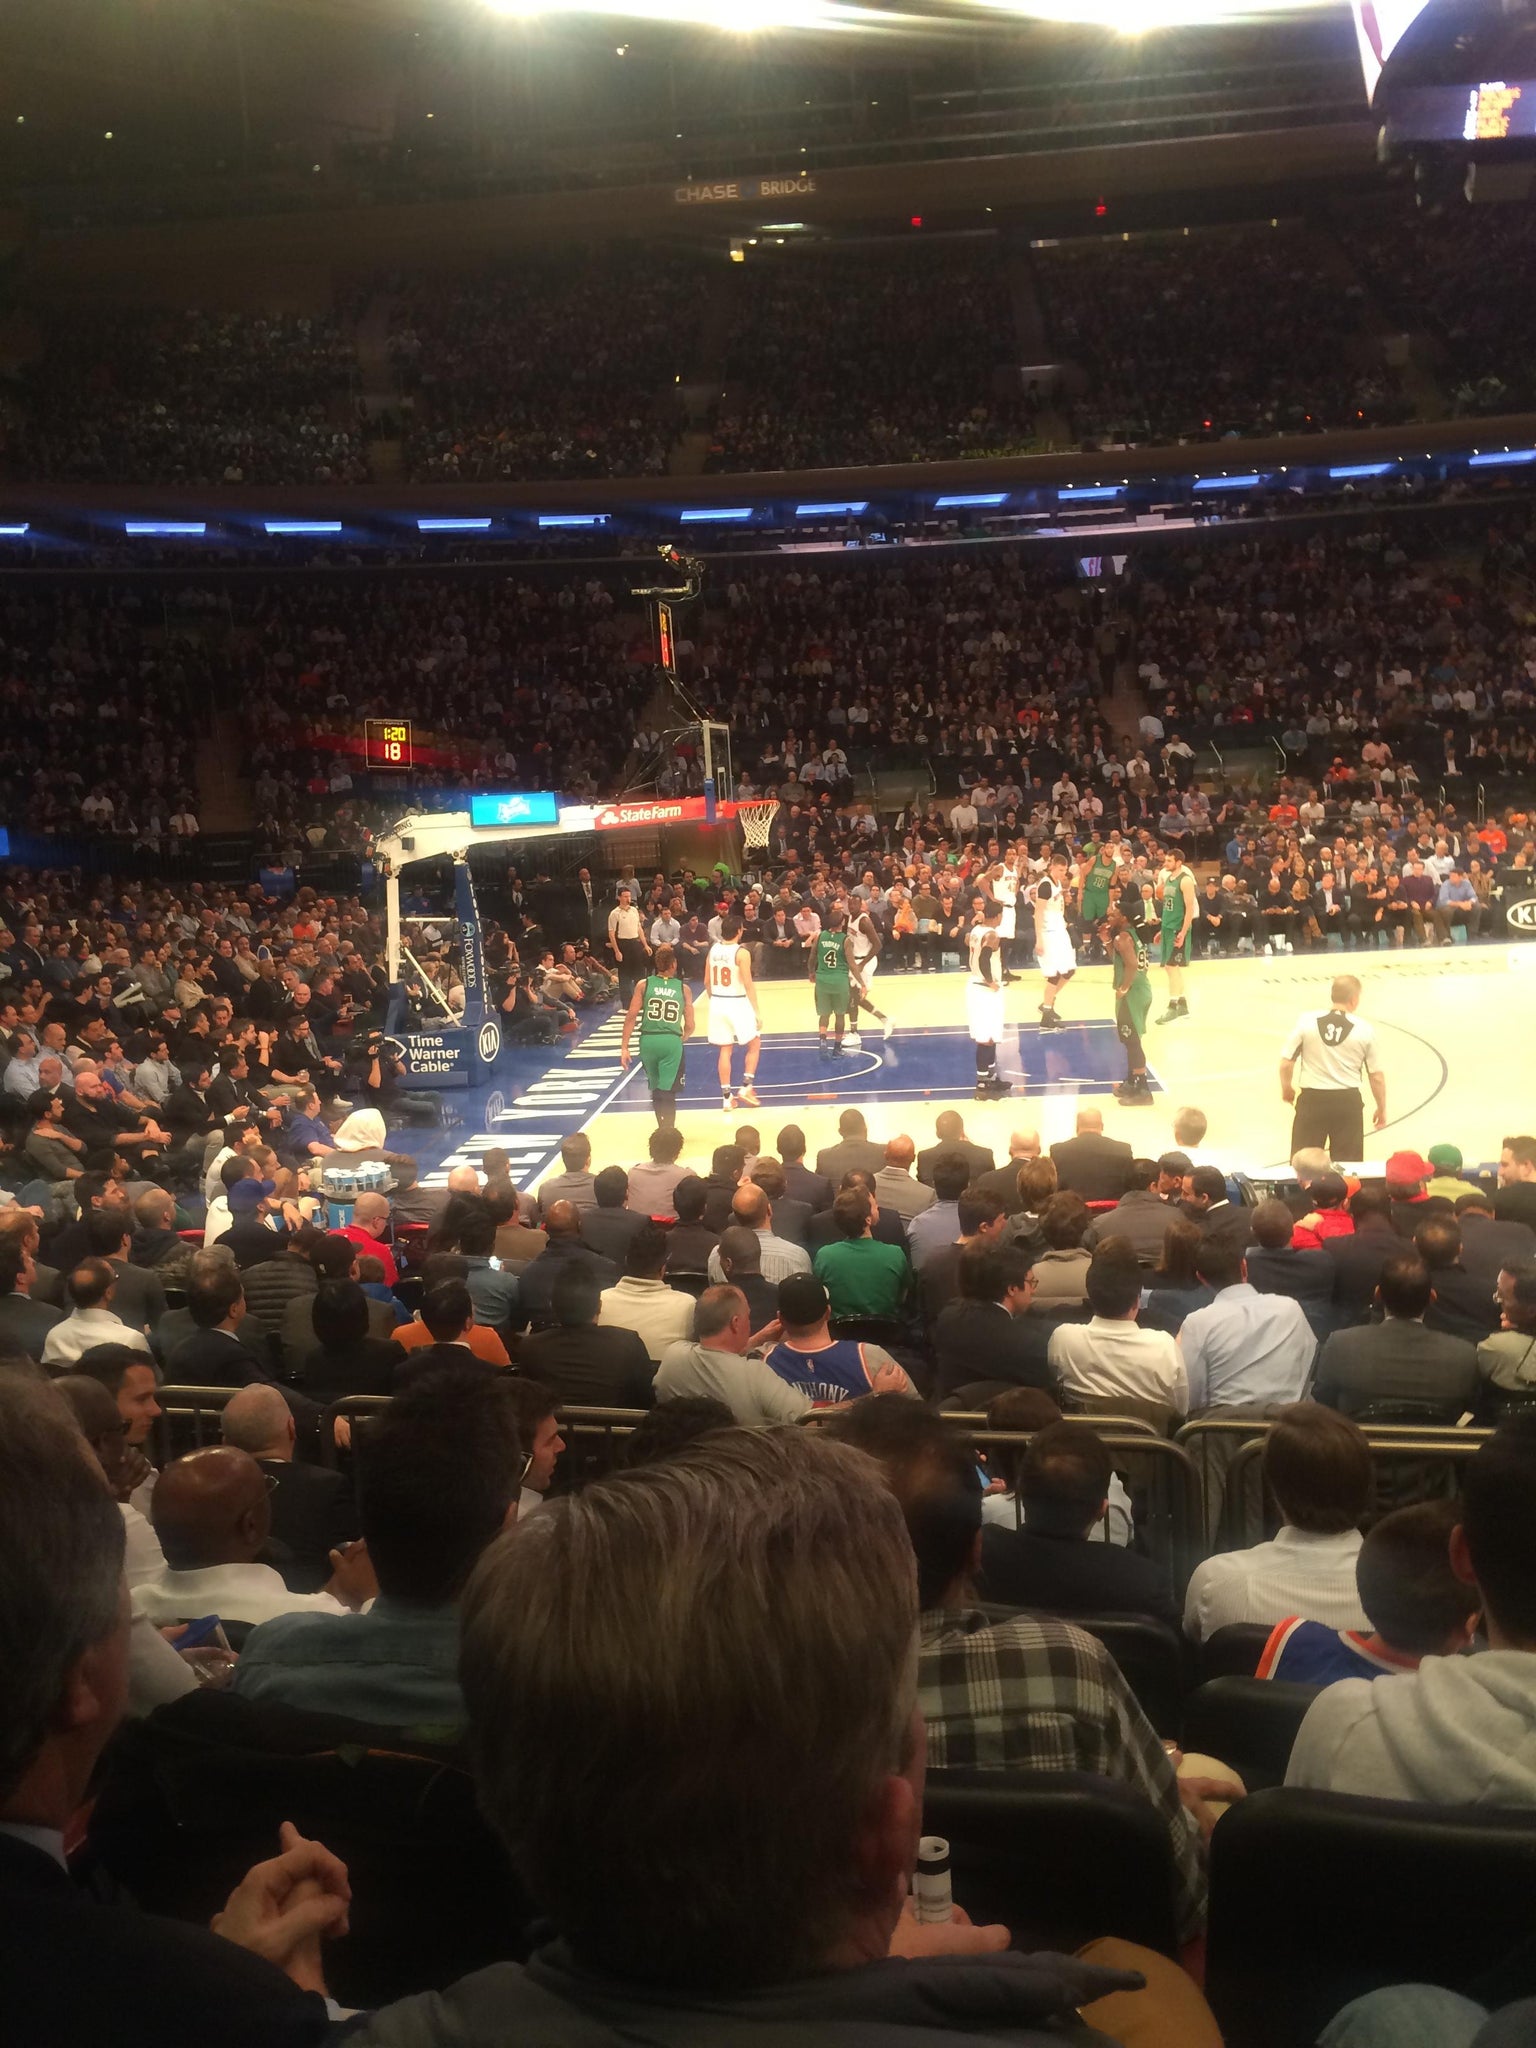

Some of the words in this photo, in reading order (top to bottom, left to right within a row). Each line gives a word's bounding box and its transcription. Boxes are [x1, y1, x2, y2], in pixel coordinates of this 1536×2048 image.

[675, 184, 739, 202] CHASE
[760, 178, 817, 196] BRIDGE
[383, 727, 406, 741] 1:20
[384, 742, 401, 761] 18
[463, 938, 477, 988] FOXWOODS
[823, 949, 837, 969] 4
[713, 965, 732, 987] 18
[653, 986, 677, 998] SMART
[647, 997, 680, 1024] 36
[408, 1035, 444, 1048] Time
[1324, 1023, 1343, 1043] 31
[409, 1048, 460, 1061] Warner
[491, 1066, 627, 1123] YORK
